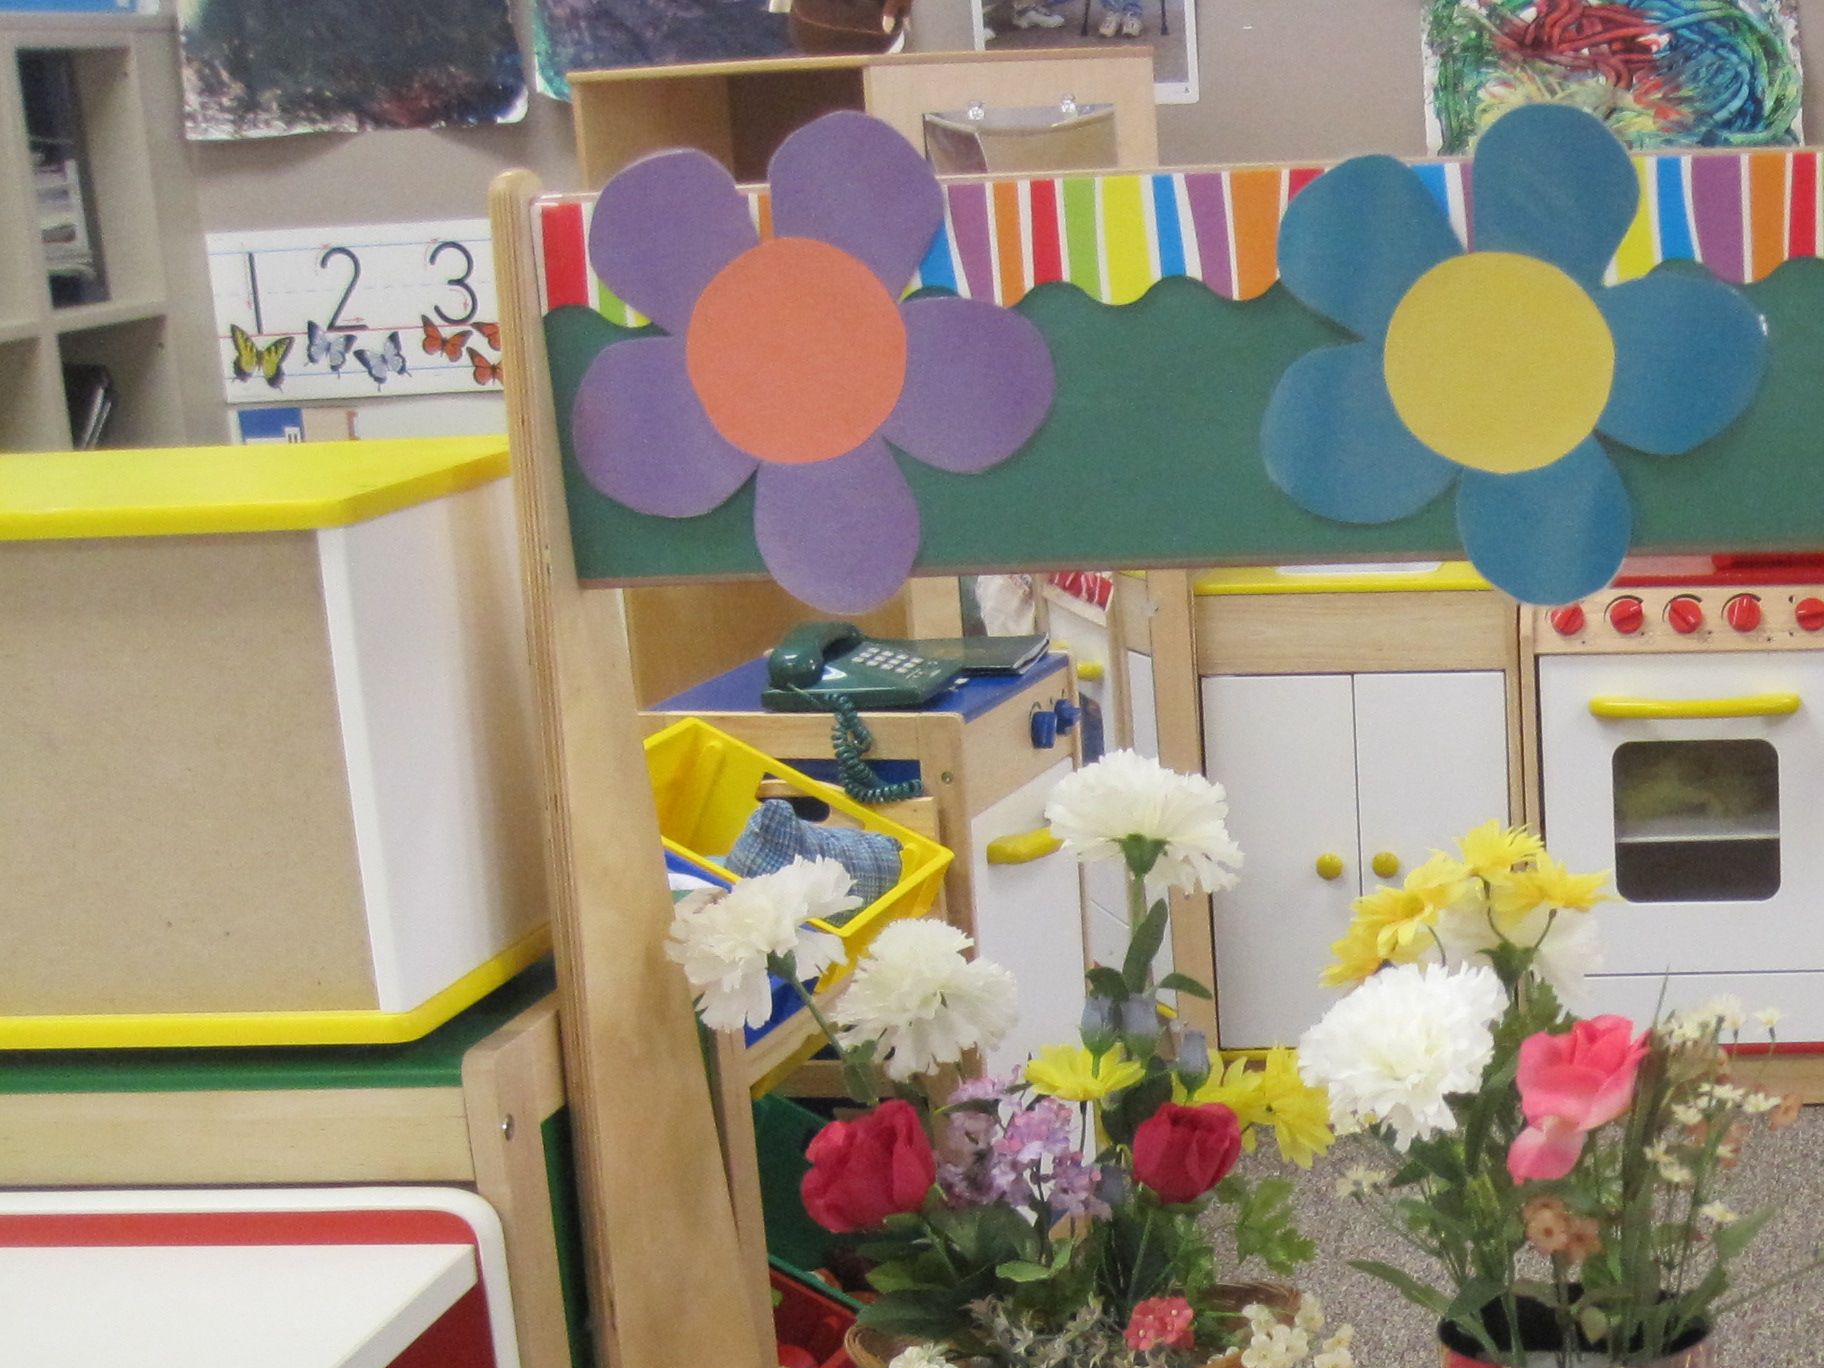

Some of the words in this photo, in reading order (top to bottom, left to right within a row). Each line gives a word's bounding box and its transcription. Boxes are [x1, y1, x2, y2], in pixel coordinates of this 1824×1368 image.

[248, 251, 263, 334] 1
[320, 246, 369, 331] 2
[429, 241, 478, 325] 3
